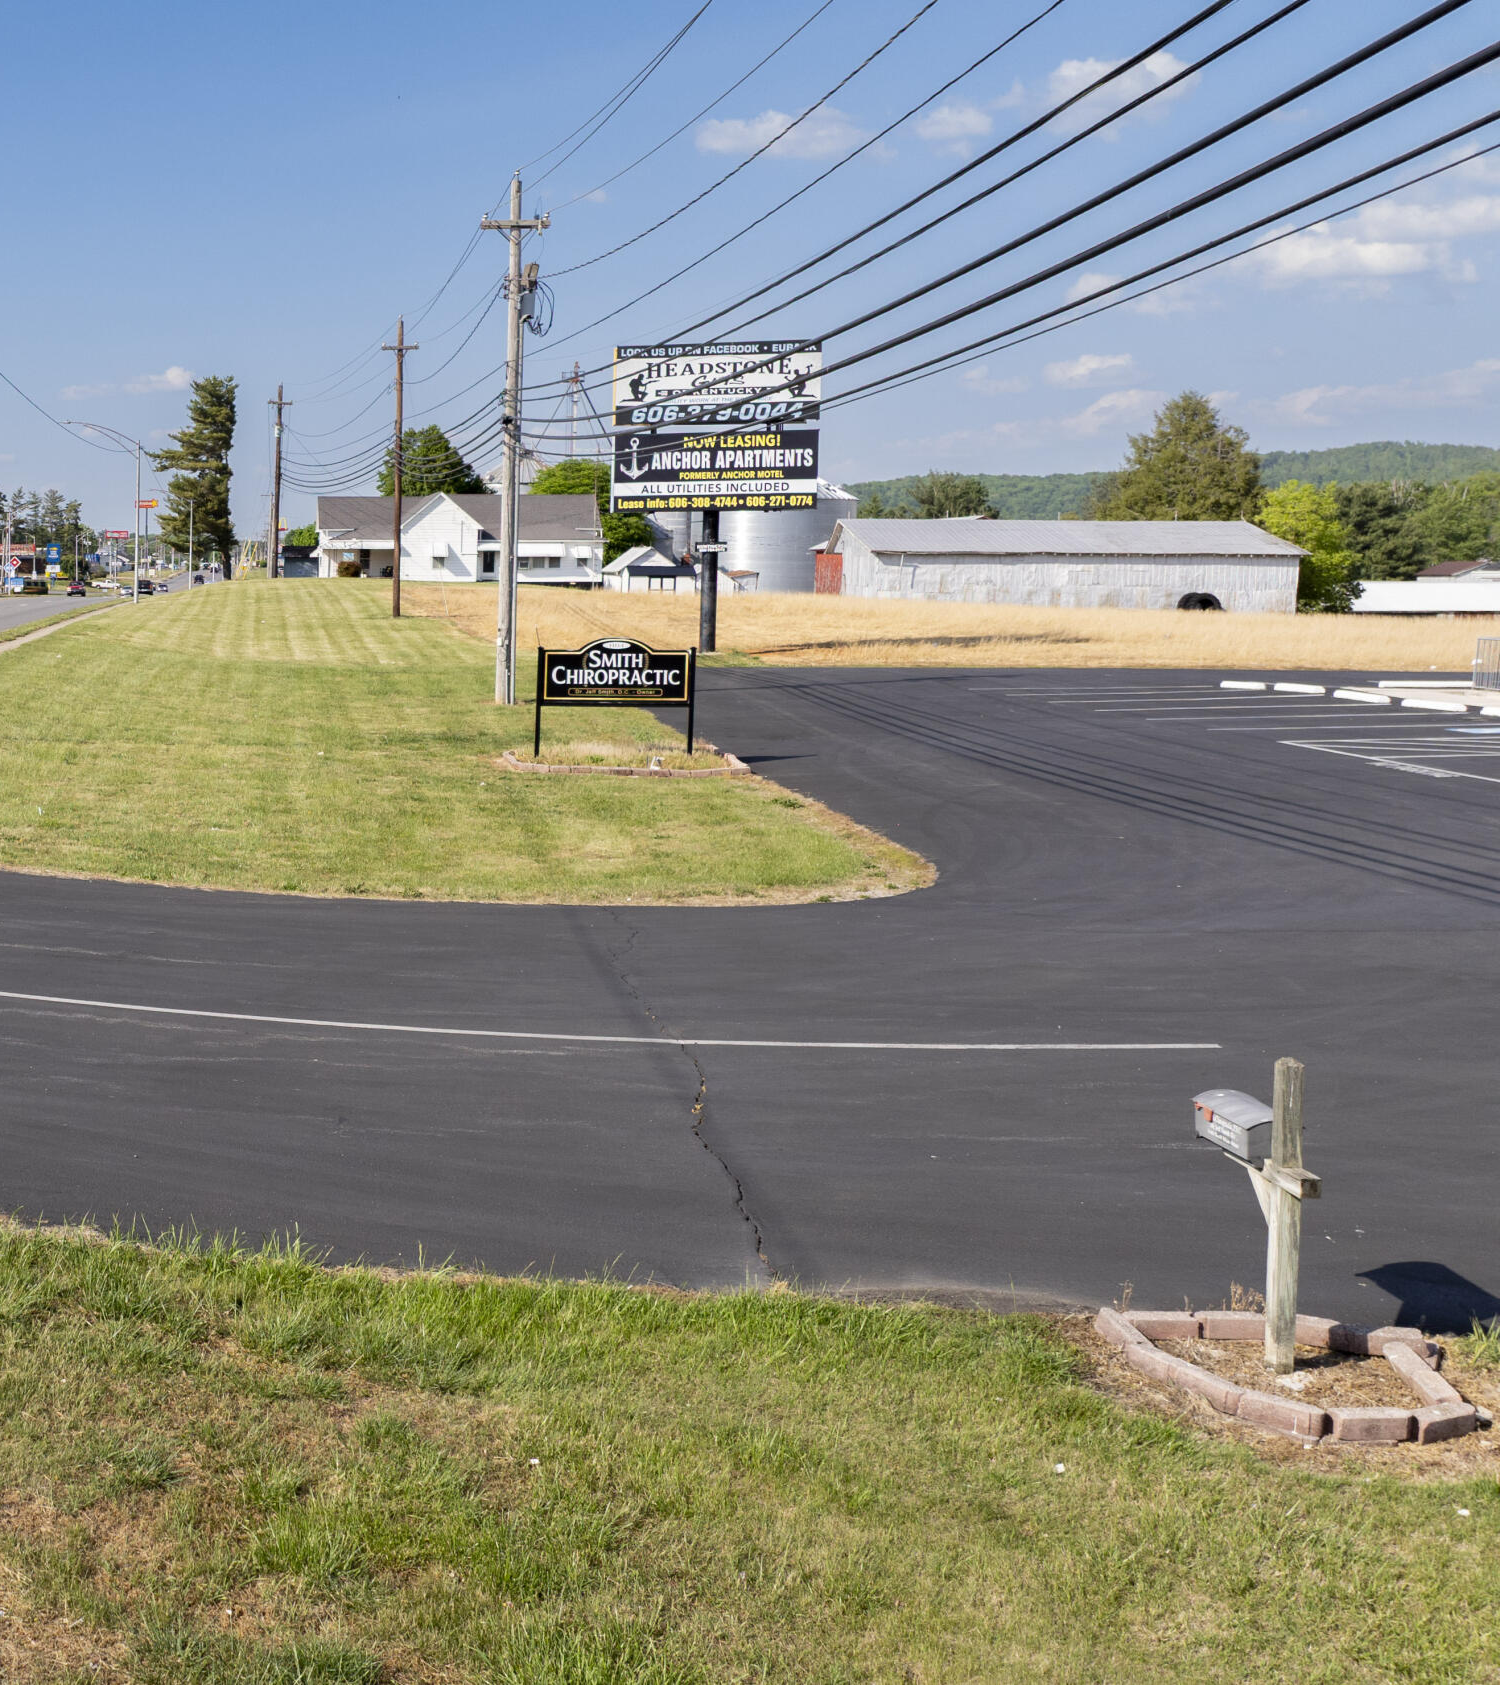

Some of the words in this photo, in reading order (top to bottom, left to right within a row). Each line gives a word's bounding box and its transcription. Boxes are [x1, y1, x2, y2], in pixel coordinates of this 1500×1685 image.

[651, 347, 665, 356] US
[668, 347, 683, 355] UP
[703, 344, 759, 354] FACEBOOK
[646, 358, 791, 378] HEADSTONE
[684, 436, 717, 448] NOW
[720, 434, 780, 448] LEASING!
[651, 451, 711, 470] ANCHOR
[715, 448, 813, 468] APARTMENTS
[679, 471, 720, 480] FORMERLY
[721, 471, 755, 479] ANCHOR
[757, 470, 784, 478] MOTEL
[641, 485, 662, 494] ALL
[667, 483, 722, 493] UTILITIES
[726, 482, 790, 492] INCLUDED
[618, 498, 644, 509] Lease
[647, 498, 668, 508] info:
[668, 496, 737, 508] 606-308-4744
[746, 495, 813, 507] 606-271-0774
[588, 650, 643, 668] SMITH
[551, 666, 680, 685] CHIROPRACTIC
